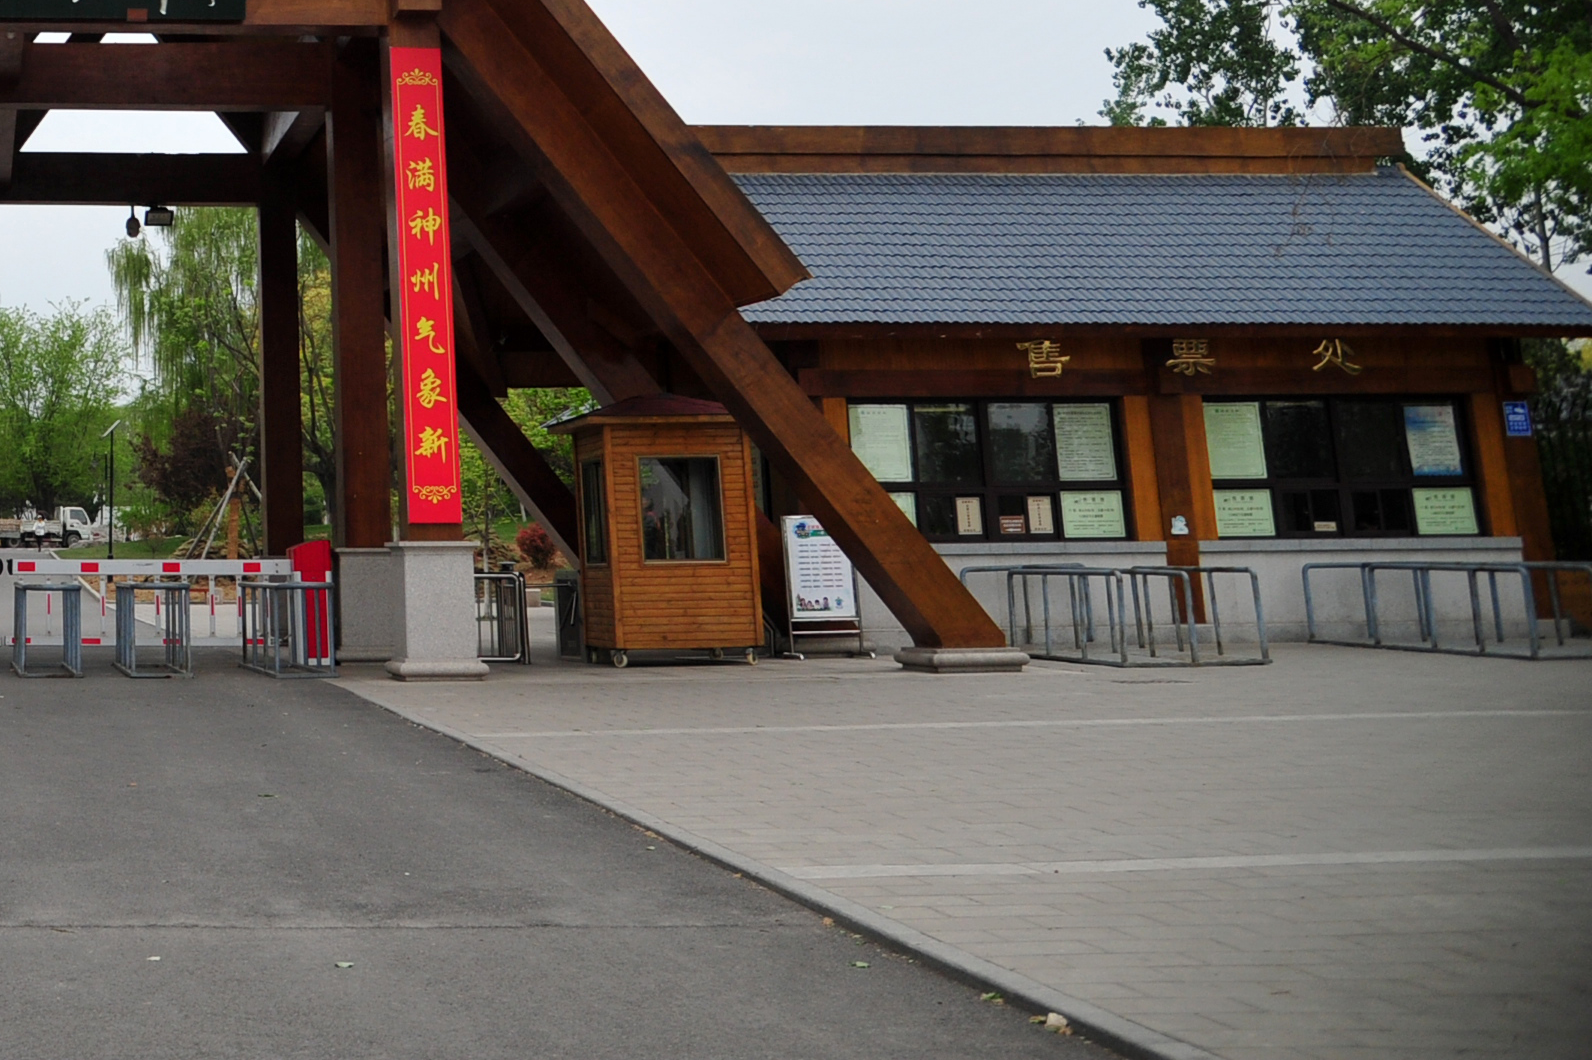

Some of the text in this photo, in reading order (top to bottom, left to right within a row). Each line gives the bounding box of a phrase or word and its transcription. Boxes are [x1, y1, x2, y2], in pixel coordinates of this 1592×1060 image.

[404, 103, 450, 464] 春满神州气象新
[1016, 339, 1362, 378] 售票处
